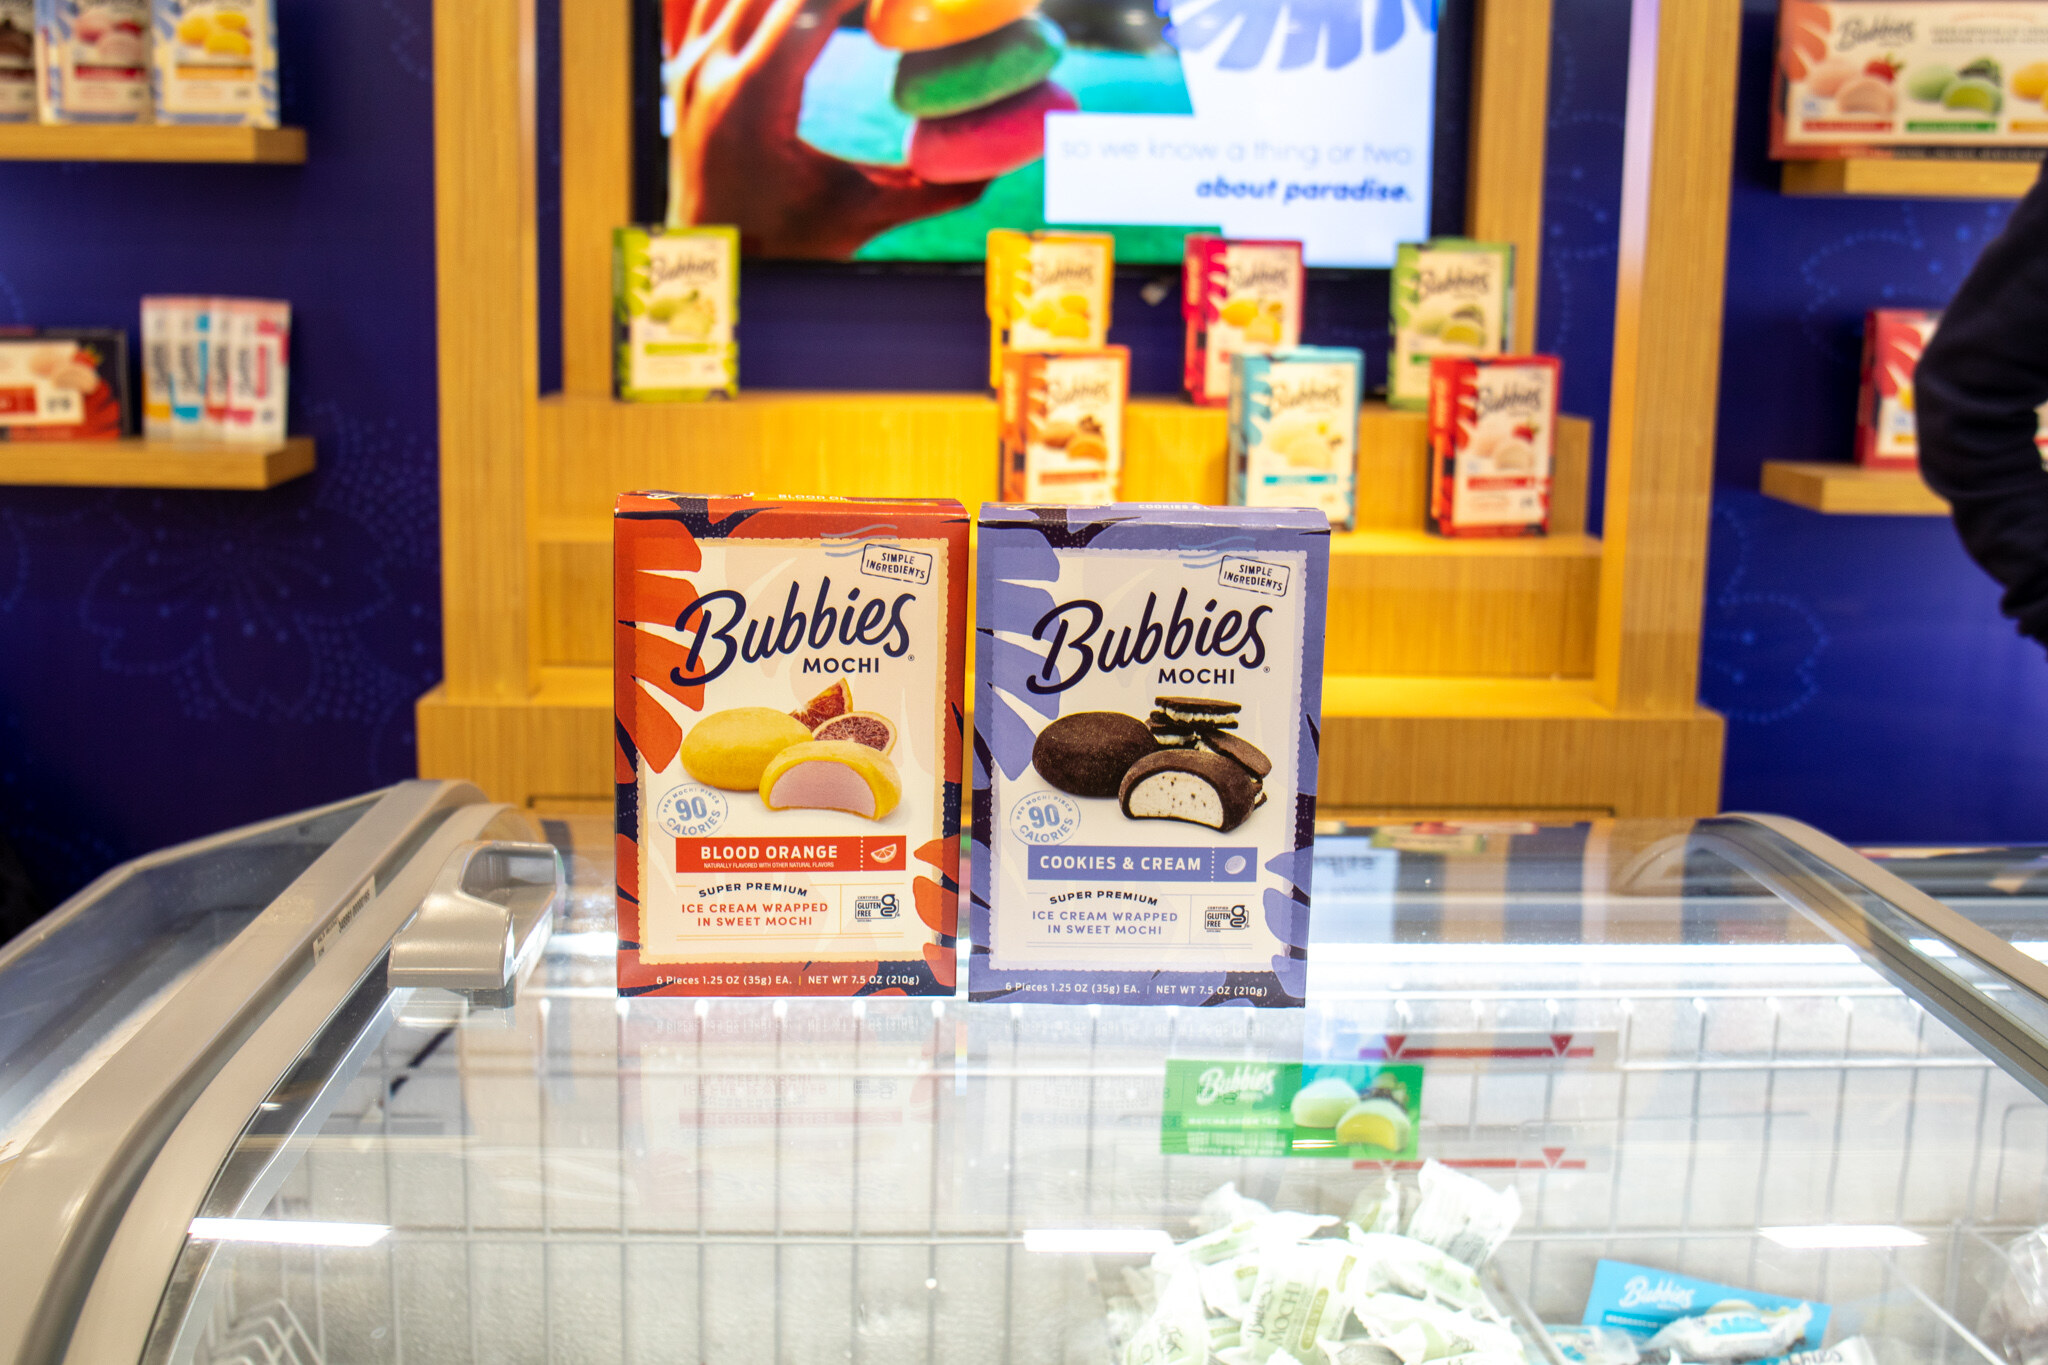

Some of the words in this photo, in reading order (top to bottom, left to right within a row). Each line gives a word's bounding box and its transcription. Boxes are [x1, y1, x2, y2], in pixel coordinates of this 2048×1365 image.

[1061, 140, 1089, 160] so
[1101, 141, 1138, 160] we
[1149, 137, 1218, 161] know
[1226, 142, 1244, 161] a
[1251, 138, 1318, 169] thing
[1327, 142, 1353, 163] or
[1362, 143, 1412, 165] two
[1196, 176, 1276, 199] about
[1284, 177, 1412, 205] paradise.
[881, 552, 915, 565] SIMPLE
[866, 559, 925, 579] INGREDIENTS
[1239, 564, 1272, 577] SIMPLE
[1223, 571, 1283, 591] INGREDIENTS
[670, 576, 916, 686] Bubbies
[1026, 587, 1273, 695] Bubbies
[802, 657, 880, 674] MOCHI
[1158, 668, 1235, 685] MOCHI
[675, 796, 707, 821] 90
[1028, 803, 1060, 829] 90
[667, 810, 721, 836] CALORIES
[1019, 817, 1074, 843] CALORIES
[701, 846, 759, 860] BLOOD
[765, 845, 838, 859] ORANGE
[1040, 856, 1116, 870] COOKIES
[1122, 857, 1134, 870] &
[1141, 857, 1201, 871] CREAM
[698, 883, 741, 898] SUPER
[746, 882, 808, 897] PREMIUM
[1049, 891, 1092, 905] SUPER
[1097, 890, 1158, 906] PREMIUM
[681, 904, 704, 913] ICE
[709, 904, 757, 913] CREAM
[762, 903, 828, 912] WRAPPED
[857, 902, 881, 910] GLUTEN
[697, 917, 710, 926] IN
[717, 917, 761, 926] SWEET
[765, 916, 812, 926] MOCHI
[1032, 911, 1054, 920] ICE
[1060, 911, 1107, 921] CREAM
[1113, 912, 1178, 922] WRAPPED
[1207, 912, 1231, 920] GLUTEN
[1047, 924, 1061, 934] IN
[1066, 924, 1110, 934] SWEET
[1115, 925, 1162, 935] MOCHI
[656, 976, 663, 985] 6
[666, 976, 699, 985] Pieces
[702, 976, 723, 985] 1.25
[726, 976, 740, 985] OZ
[743, 974, 772, 987] (35g)
[776, 976, 793, 985] EA.
[808, 976, 828, 985] NET
[832, 976, 848, 985] WT
[851, 976, 866, 985] 7.5
[869, 976, 883, 985] OZ
[886, 974, 920, 986] (210g)
[1005, 982, 1012, 991] 6
[1015, 982, 1048, 992] Pieces
[1051, 983, 1071, 992] 1.25
[1074, 983, 1088, 992] OZ
[1091, 982, 1120, 995] (35g)
[1124, 984, 1140, 994] EA.
[1156, 985, 1176, 994] NET
[1180, 985, 1196, 994] WT
[1200, 985, 1213, 995] 7.5
[1216, 986, 1230, 995] OZ
[1234, 985, 1268, 997] (210g)
[1196, 1064, 1277, 1106] Bubbies
[1618, 1275, 1696, 1309] Bubbies
